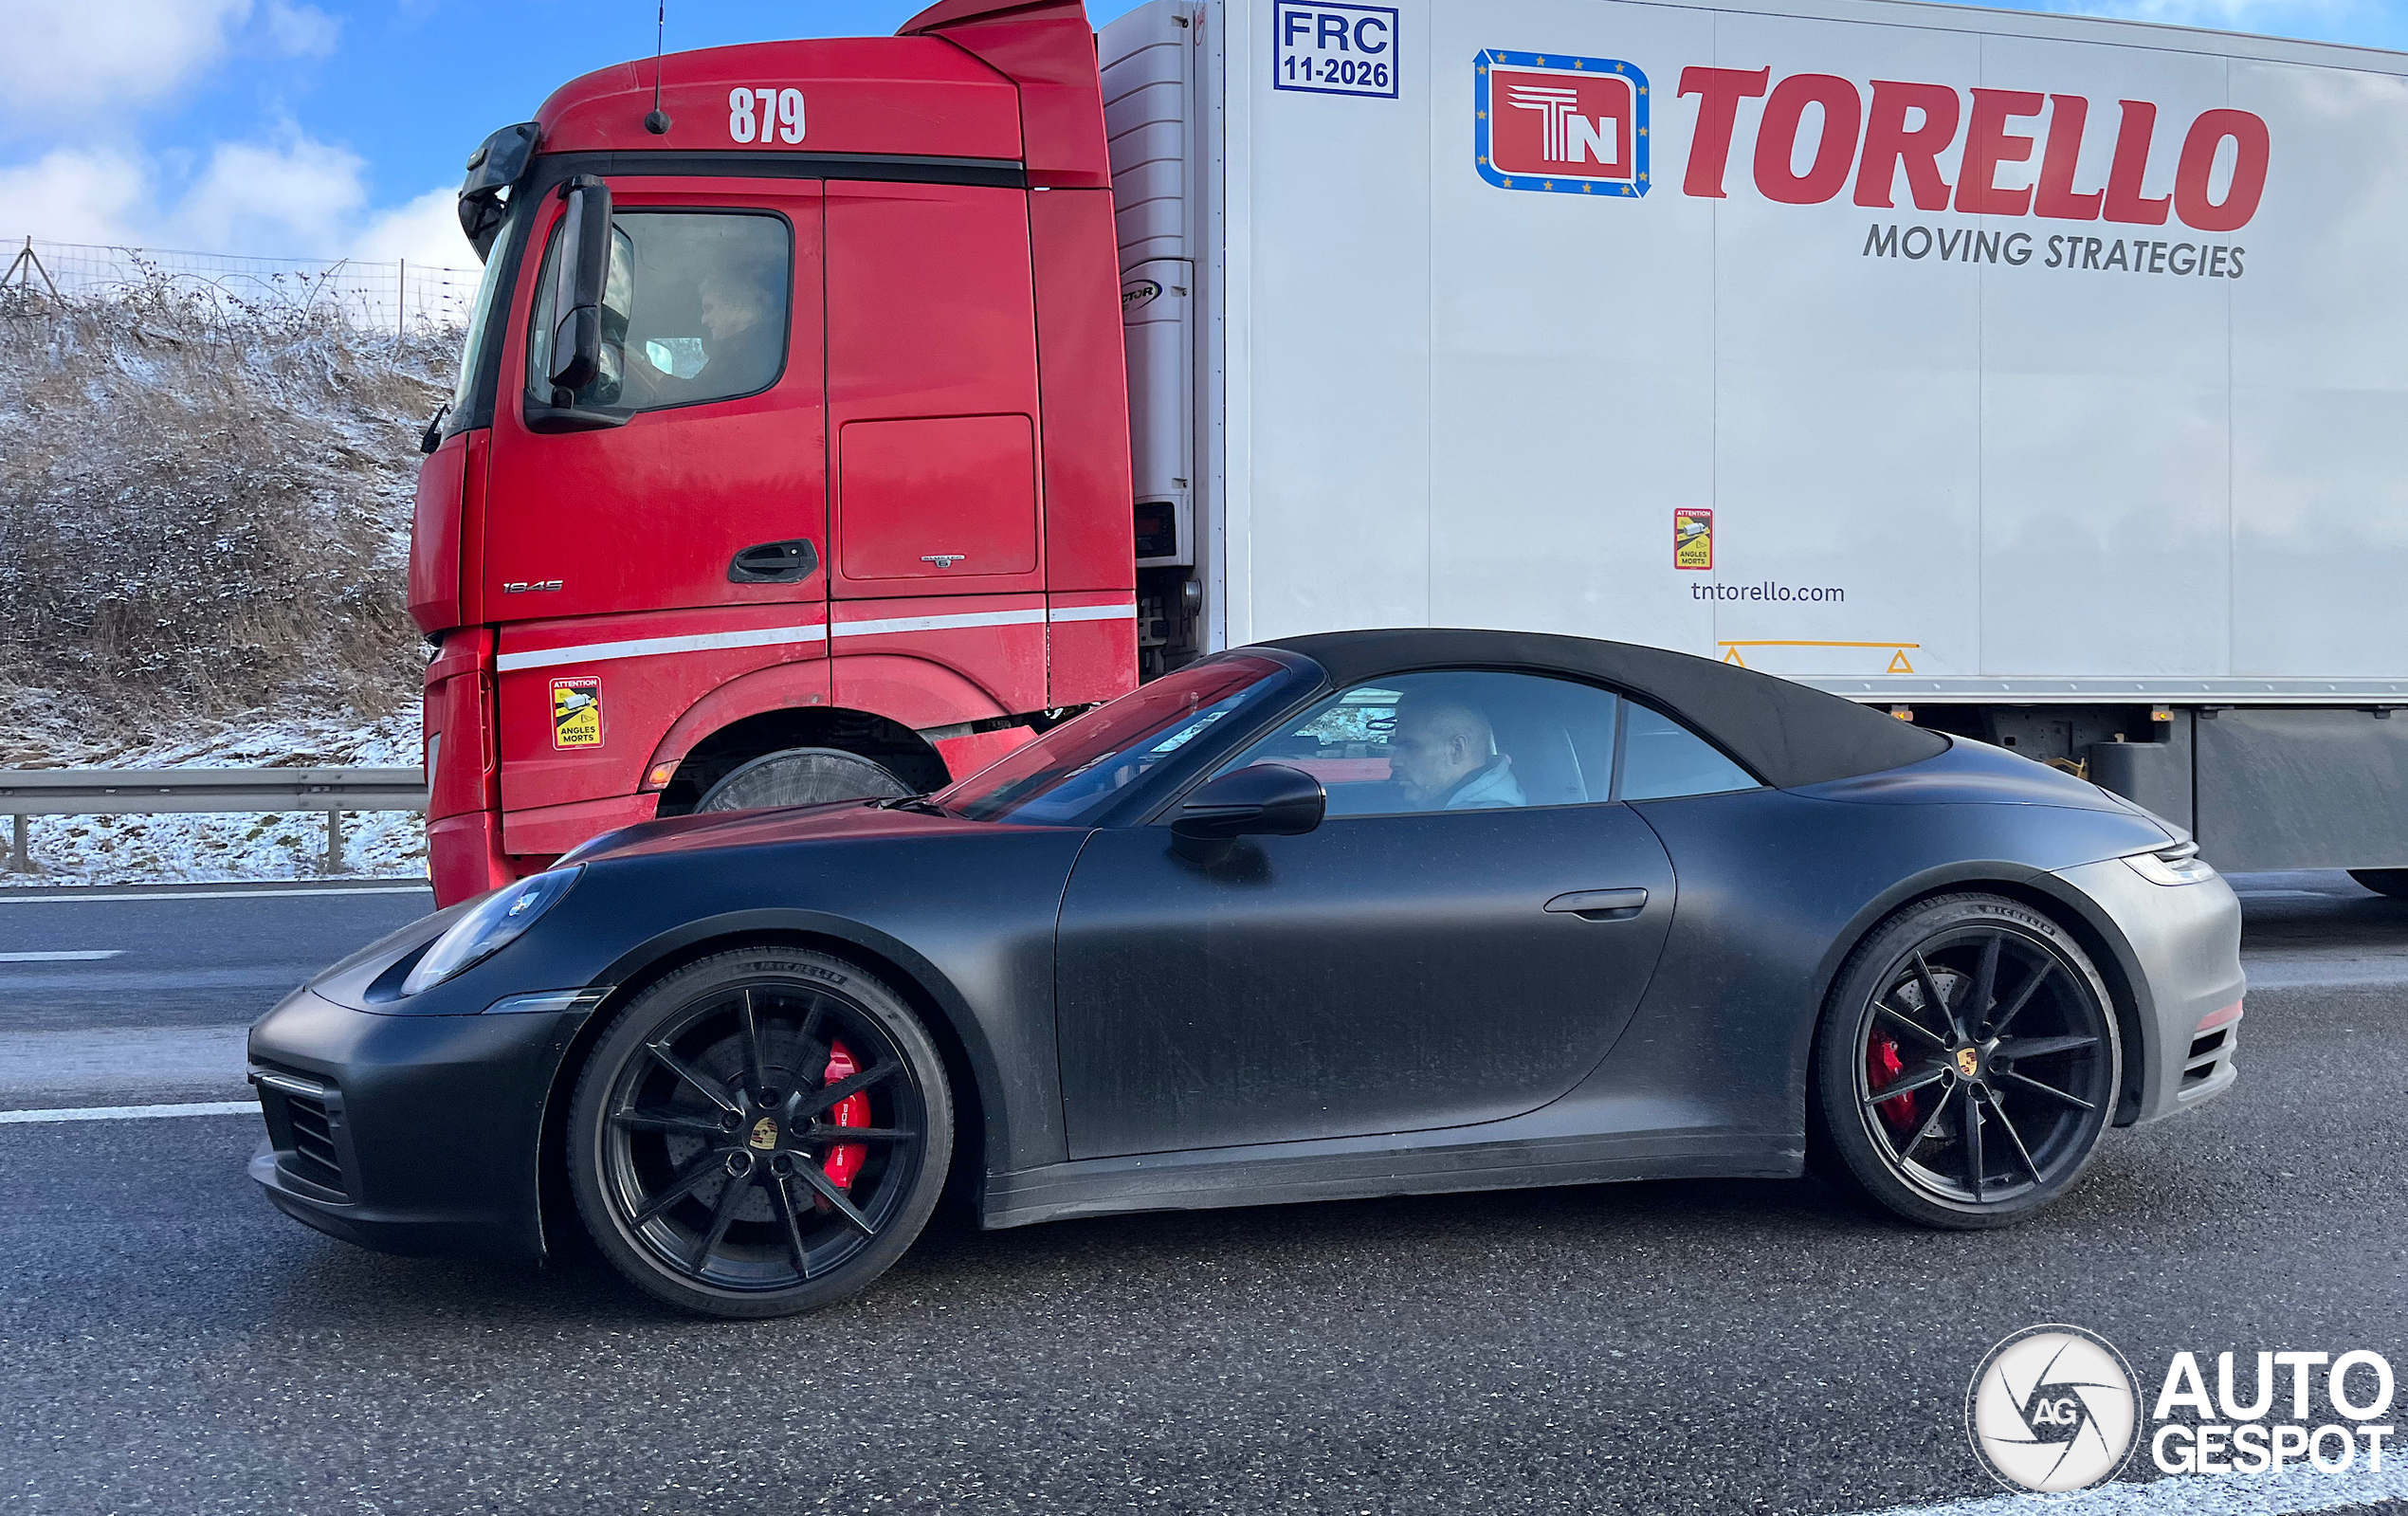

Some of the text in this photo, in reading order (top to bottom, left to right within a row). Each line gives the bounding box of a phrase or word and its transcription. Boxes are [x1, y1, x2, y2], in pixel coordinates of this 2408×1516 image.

[1285, 10, 1388, 54] FRC
[1284, 55, 1389, 87] 11-2026
[728, 86, 806, 144] 879
[1506, 84, 1618, 165] TN
[1676, 65, 2271, 232] TORELLO
[1862, 224, 2247, 280] MOVING STRATEGIES
[503, 579, 563, 594] 1845
[1691, 581, 1845, 602] tntorello.com
[554, 679, 597, 688] ATTENTION
[560, 726, 595, 735] ANGLES
[563, 734, 594, 742] MORTS
